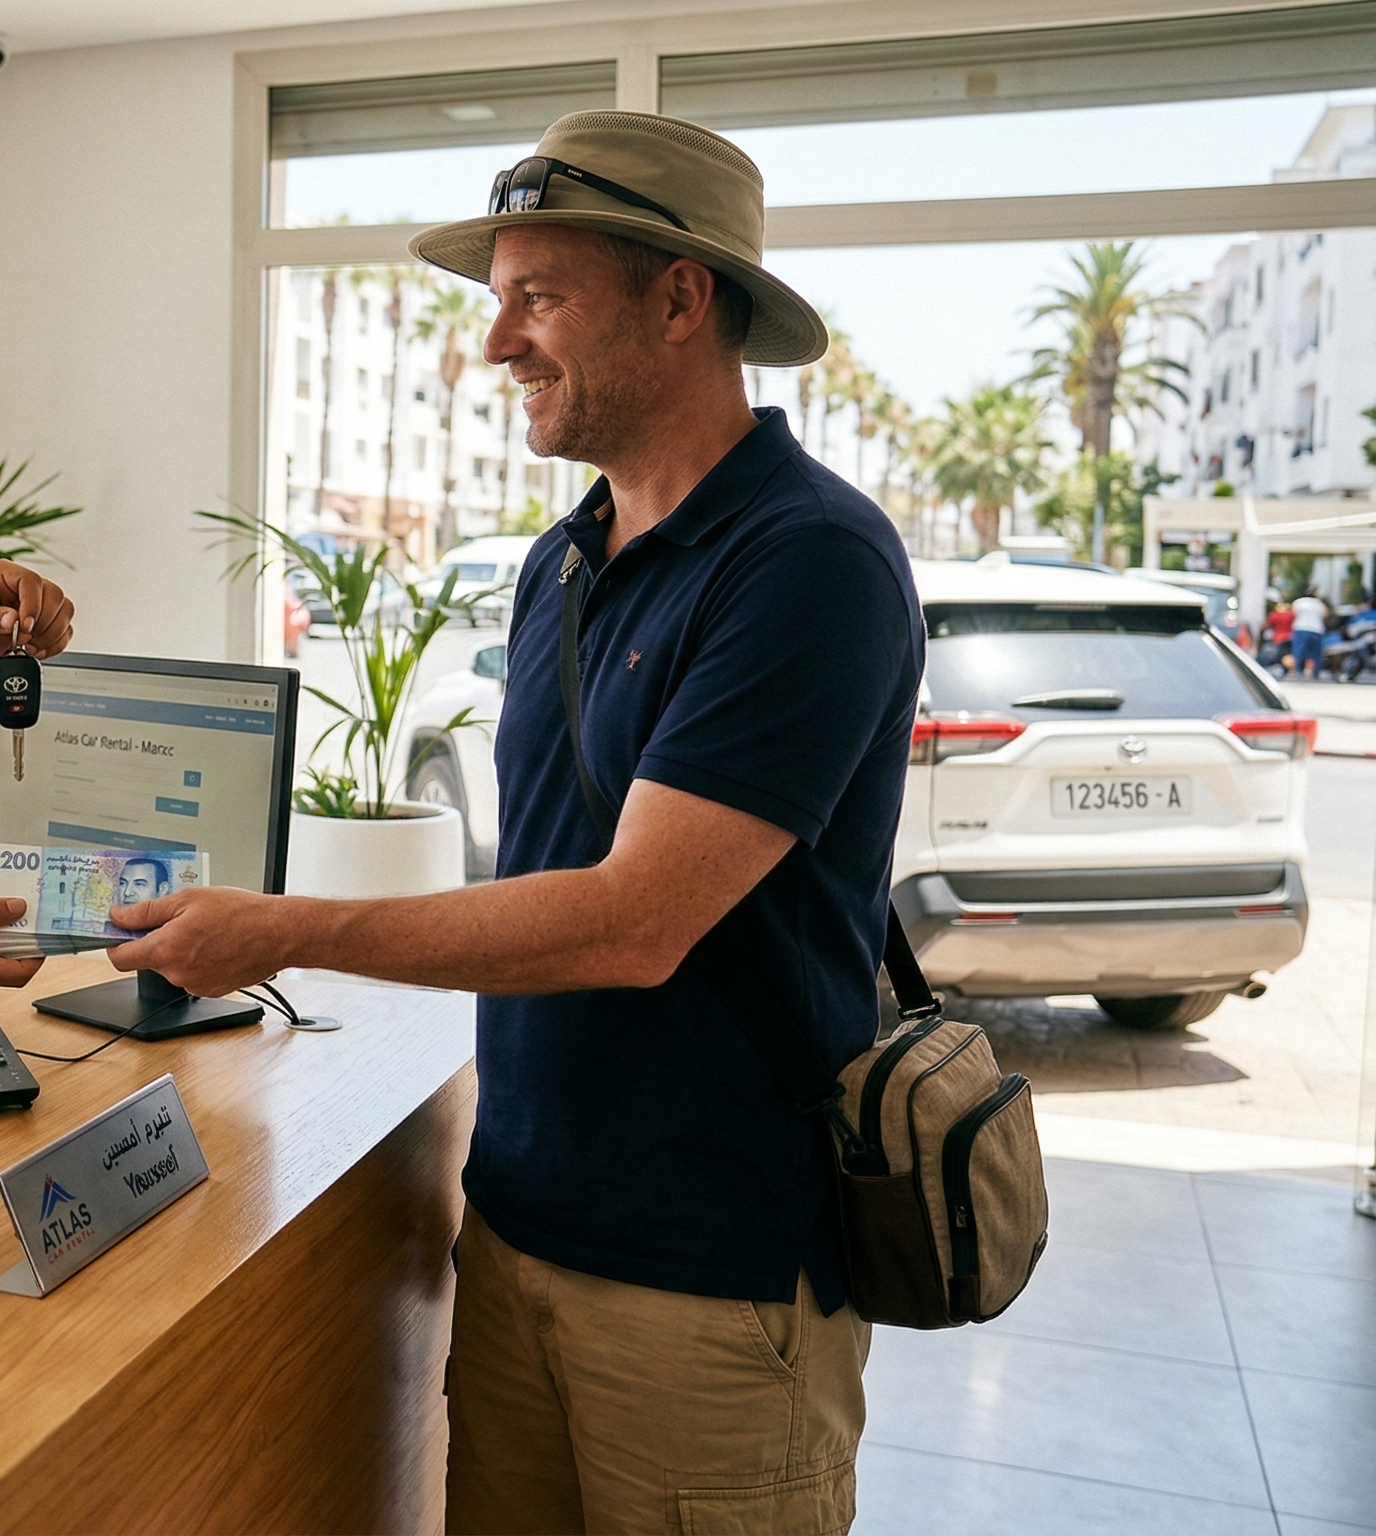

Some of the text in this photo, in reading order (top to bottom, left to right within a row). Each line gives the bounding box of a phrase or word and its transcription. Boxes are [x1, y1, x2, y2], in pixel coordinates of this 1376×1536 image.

[1065, 782, 1149, 810] 123456
[1168, 782, 1181, 808] A
[0, 850, 40, 871] 200
[42, 1203, 92, 1254] ATLAS
